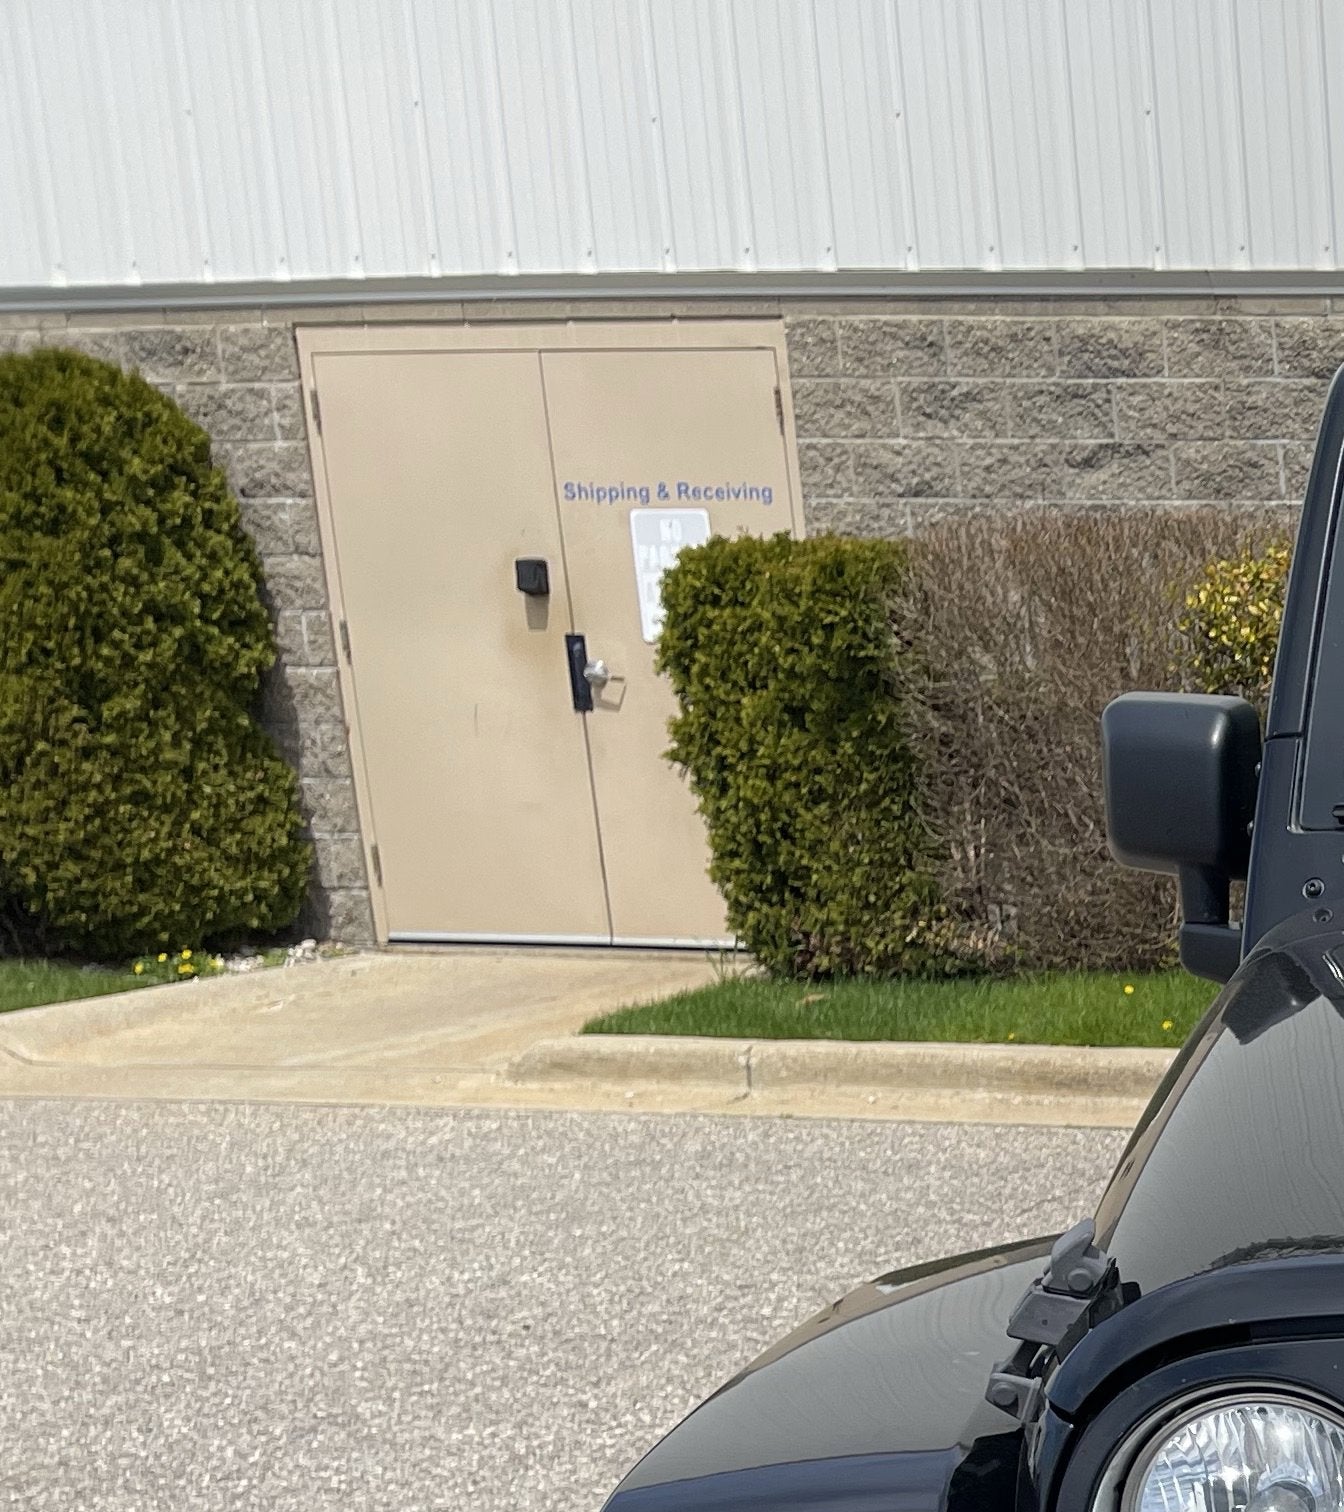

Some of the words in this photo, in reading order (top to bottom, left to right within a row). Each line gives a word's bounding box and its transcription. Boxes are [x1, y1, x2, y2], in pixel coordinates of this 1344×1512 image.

[563, 481, 650, 504] Shipping
[657, 482, 670, 498] &
[676, 482, 773, 505] Receiving
